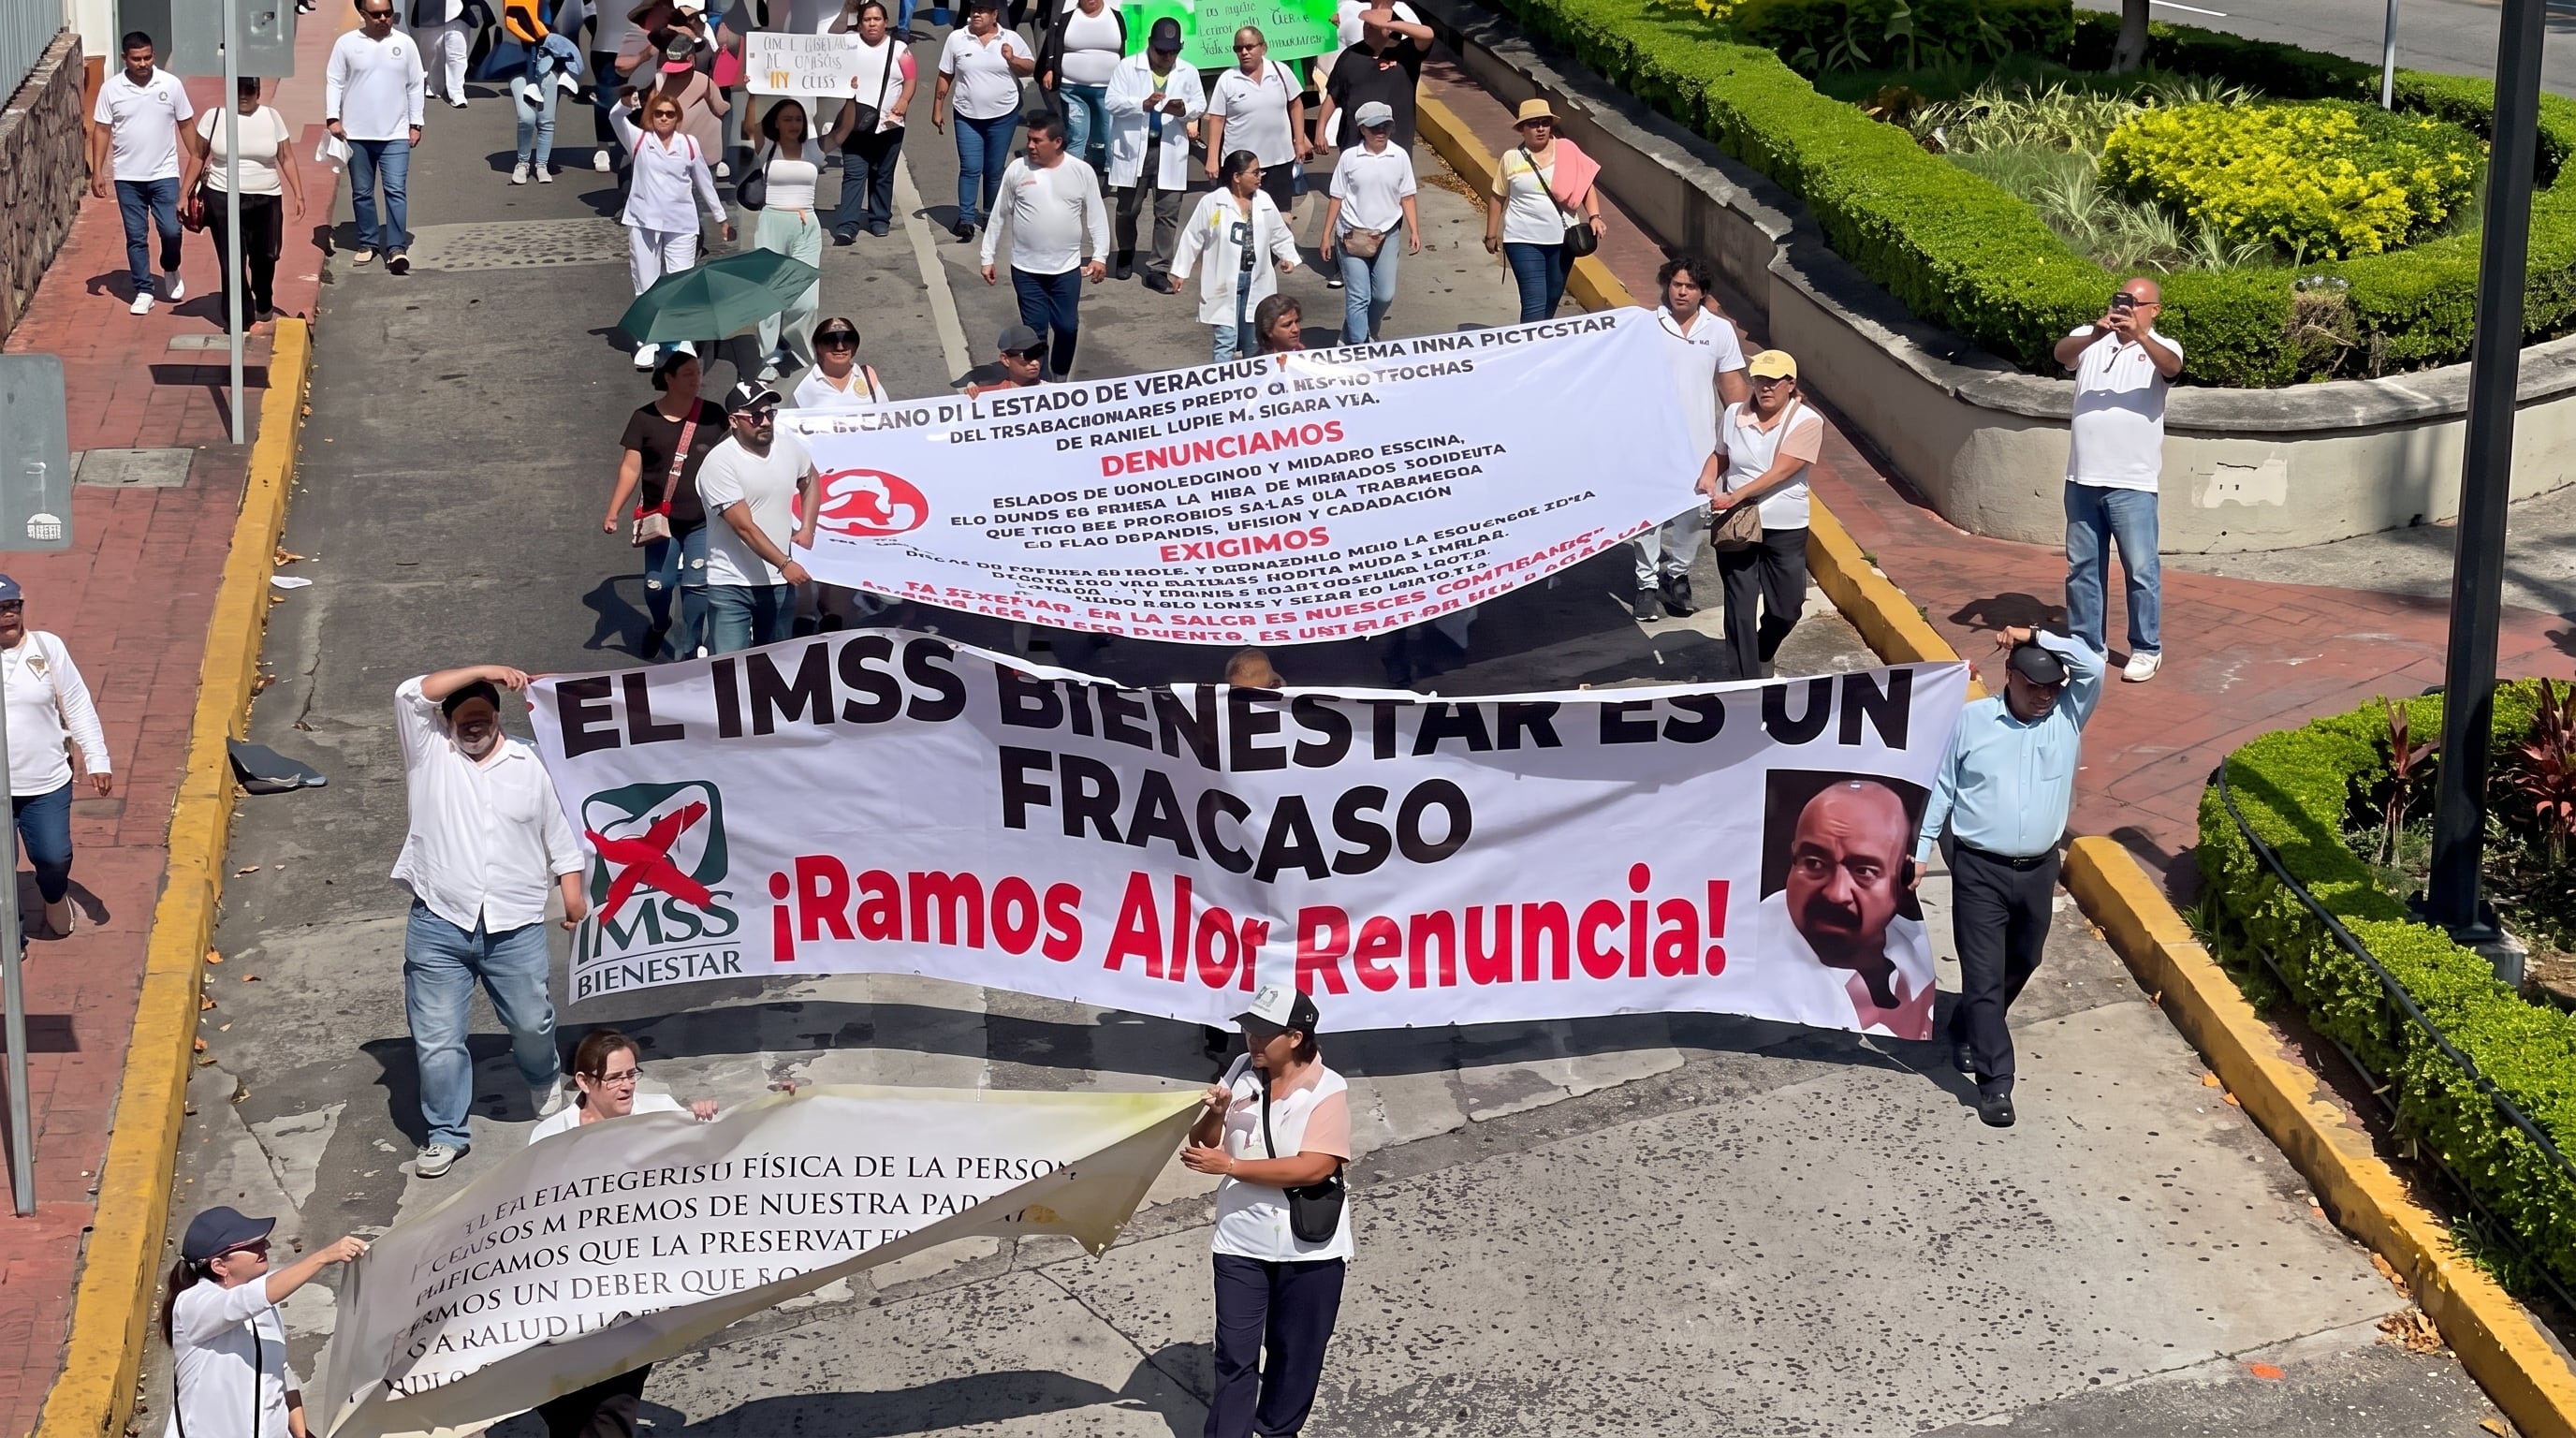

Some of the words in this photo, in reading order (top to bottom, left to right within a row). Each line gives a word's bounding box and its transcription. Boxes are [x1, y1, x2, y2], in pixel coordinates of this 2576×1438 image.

[992, 389, 1089, 418] ESTADO
[1096, 383, 1127, 404] DE
[1134, 359, 1267, 395] VERACHUS
[1413, 332, 1474, 354] INNA
[950, 428, 986, 444] DEL
[1057, 437, 1083, 451] DE
[1090, 424, 1162, 447] RANIEL
[1167, 412, 1224, 434] LUPIE
[1260, 395, 1331, 418] SIGARA
[1102, 421, 1344, 477] DENUNCIAMOS
[951, 515, 987, 526] ELO
[994, 509, 1059, 524] DUNDS
[1177, 493, 1201, 506] LA
[1211, 486, 1256, 502] HIBA
[1266, 479, 1290, 493] DE
[993, 491, 1077, 508] ESLADOS
[1084, 488, 1107, 500] DE
[1268, 462, 1280, 474] Y
[1308, 508, 1320, 520] Y
[1326, 485, 1452, 517] CADADACIÓN
[986, 527, 1025, 540] QUE
[1160, 526, 1330, 563] EXIGIMOS
[1404, 535, 1427, 547] LA
[555, 660, 685, 759] EL
[711, 634, 968, 741] IMSS
[996, 665, 1564, 773] BIENESTAR
[1599, 690, 1727, 747] ES
[1763, 668, 1913, 750] UN
[999, 744, 1472, 884] FRACASO
[578, 890, 739, 966] IMSS
[768, 854, 1082, 963] ¡Ramos
[1104, 871, 1269, 993] Alor
[1295, 862, 1730, 995] Renuncia!
[578, 950, 742, 999] BIENESTAR
[742, 1152, 844, 1180] FÍSICA
[854, 1155, 895, 1178] DE
[907, 1155, 947, 1179] LA
[956, 1157, 1066, 1180] PERSO
[541, 1213, 566, 1236] M
[578, 1197, 697, 1229] PREMOS
[710, 1194, 749, 1217] DE
[760, 1193, 911, 1216] NUESTRA
[578, 1237, 639, 1266] QUE
[651, 1234, 691, 1257] LA
[700, 1228, 871, 1255] PRESERVAT
[513, 1279, 559, 1306] UN
[571, 1270, 673, 1300] DEBER
[681, 1268, 745, 1296] QUE
